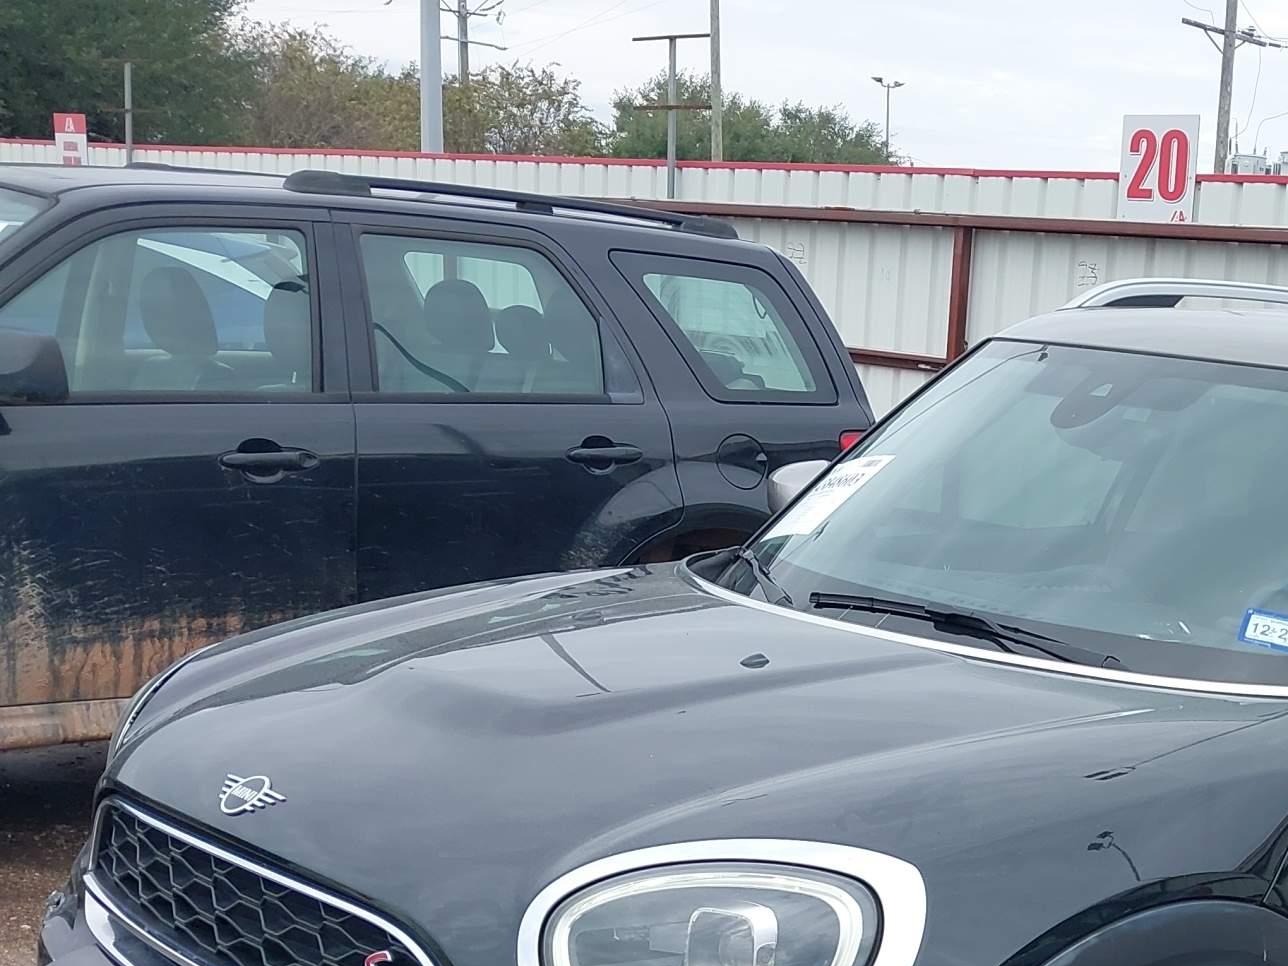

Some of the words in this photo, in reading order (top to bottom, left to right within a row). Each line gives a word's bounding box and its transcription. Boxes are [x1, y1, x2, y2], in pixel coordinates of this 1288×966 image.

[64, 117, 76, 133] A
[1126, 128, 1190, 204] 20
[1251, 622, 1272, 637] 12
[231, 784, 259, 802] MINI
